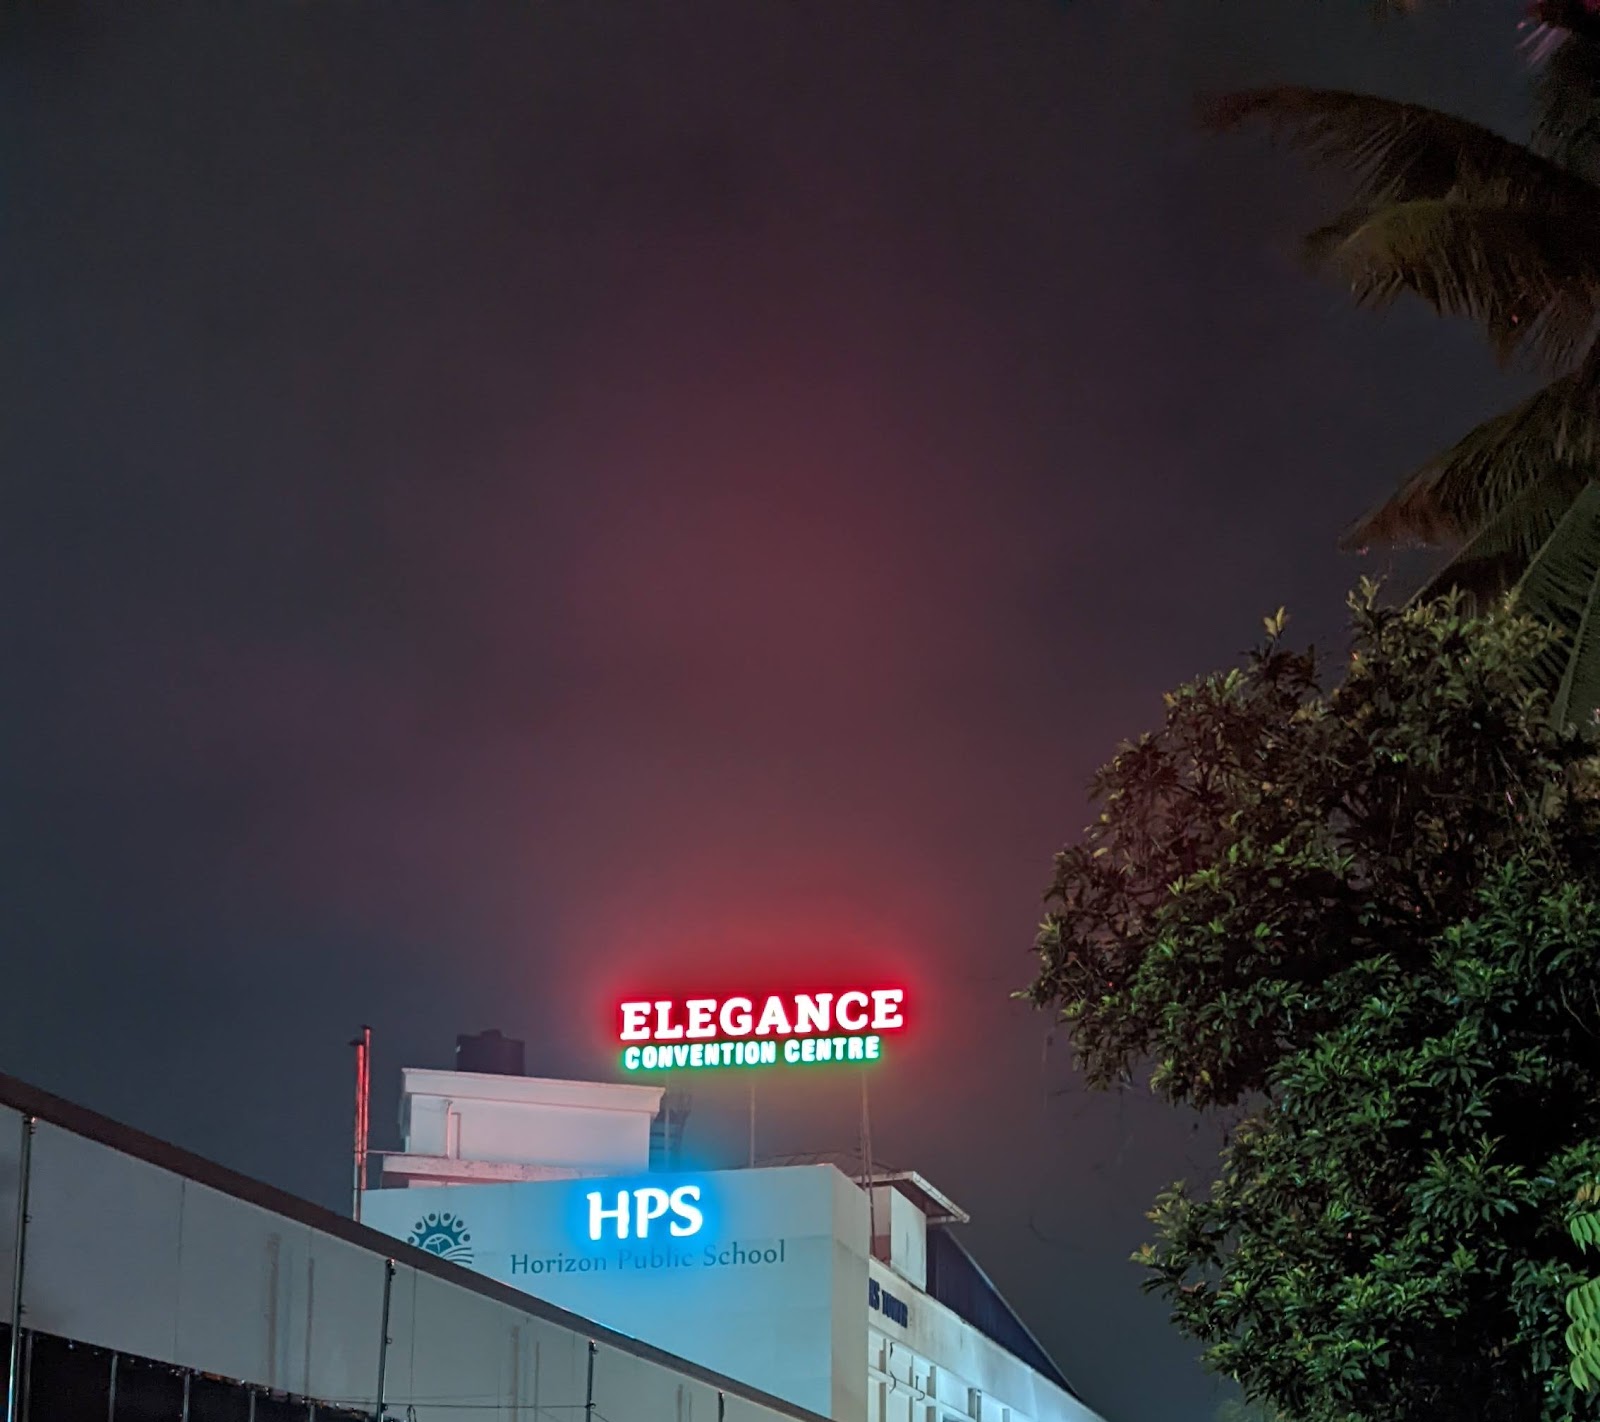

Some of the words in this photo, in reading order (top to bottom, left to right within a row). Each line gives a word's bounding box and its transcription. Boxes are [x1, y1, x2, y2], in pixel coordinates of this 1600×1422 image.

[620, 988, 903, 1040] ELEGANCE
[625, 1041, 776, 1069] CONVENTION
[784, 1035, 880, 1062] CENTRE
[586, 1184, 704, 1240] HPS
[511, 1253, 607, 1275] Horizon
[618, 1248, 693, 1271] Public
[703, 1239, 785, 1266] School
